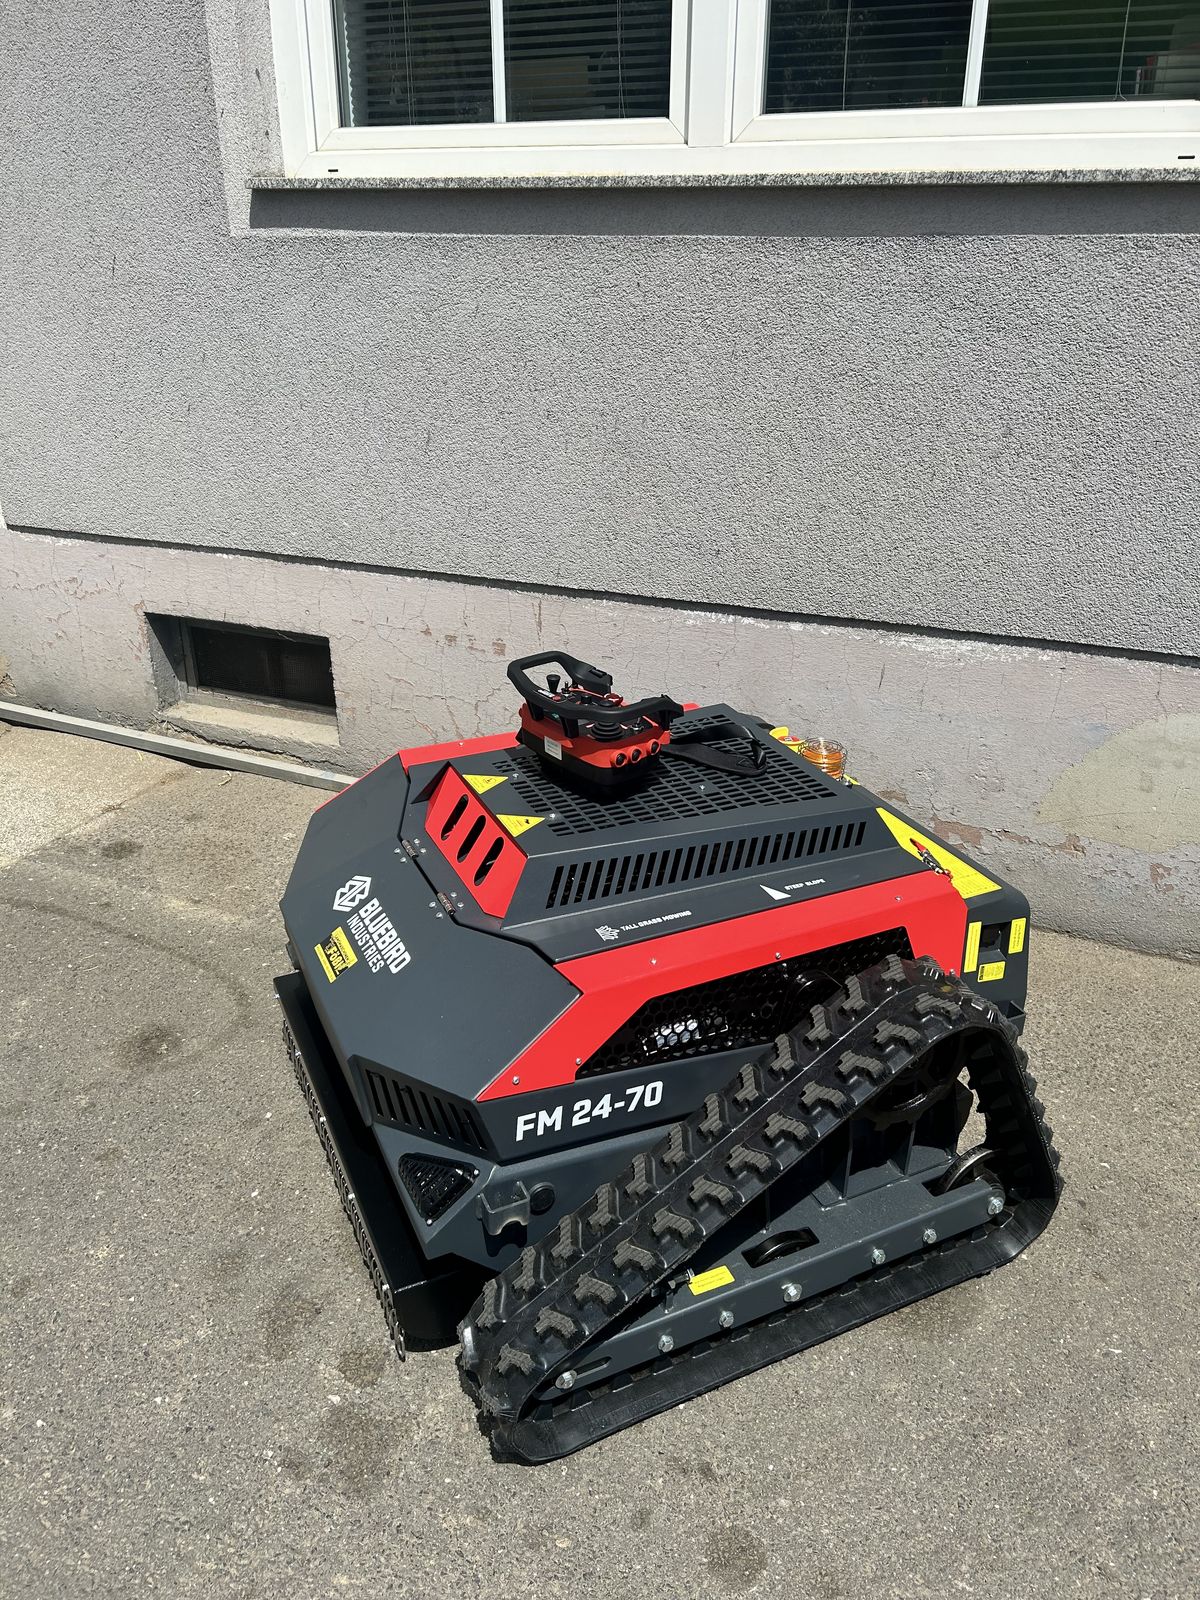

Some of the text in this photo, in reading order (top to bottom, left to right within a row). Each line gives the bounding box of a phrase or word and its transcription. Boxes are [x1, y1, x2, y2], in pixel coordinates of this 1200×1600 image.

[346, 912, 385, 974] INDUSTRIES
[359, 897, 412, 974] BLUEBIRD
[620, 910, 692, 931] TALL GRASS MOWING
[515, 1080, 664, 1142] FM 24-70
